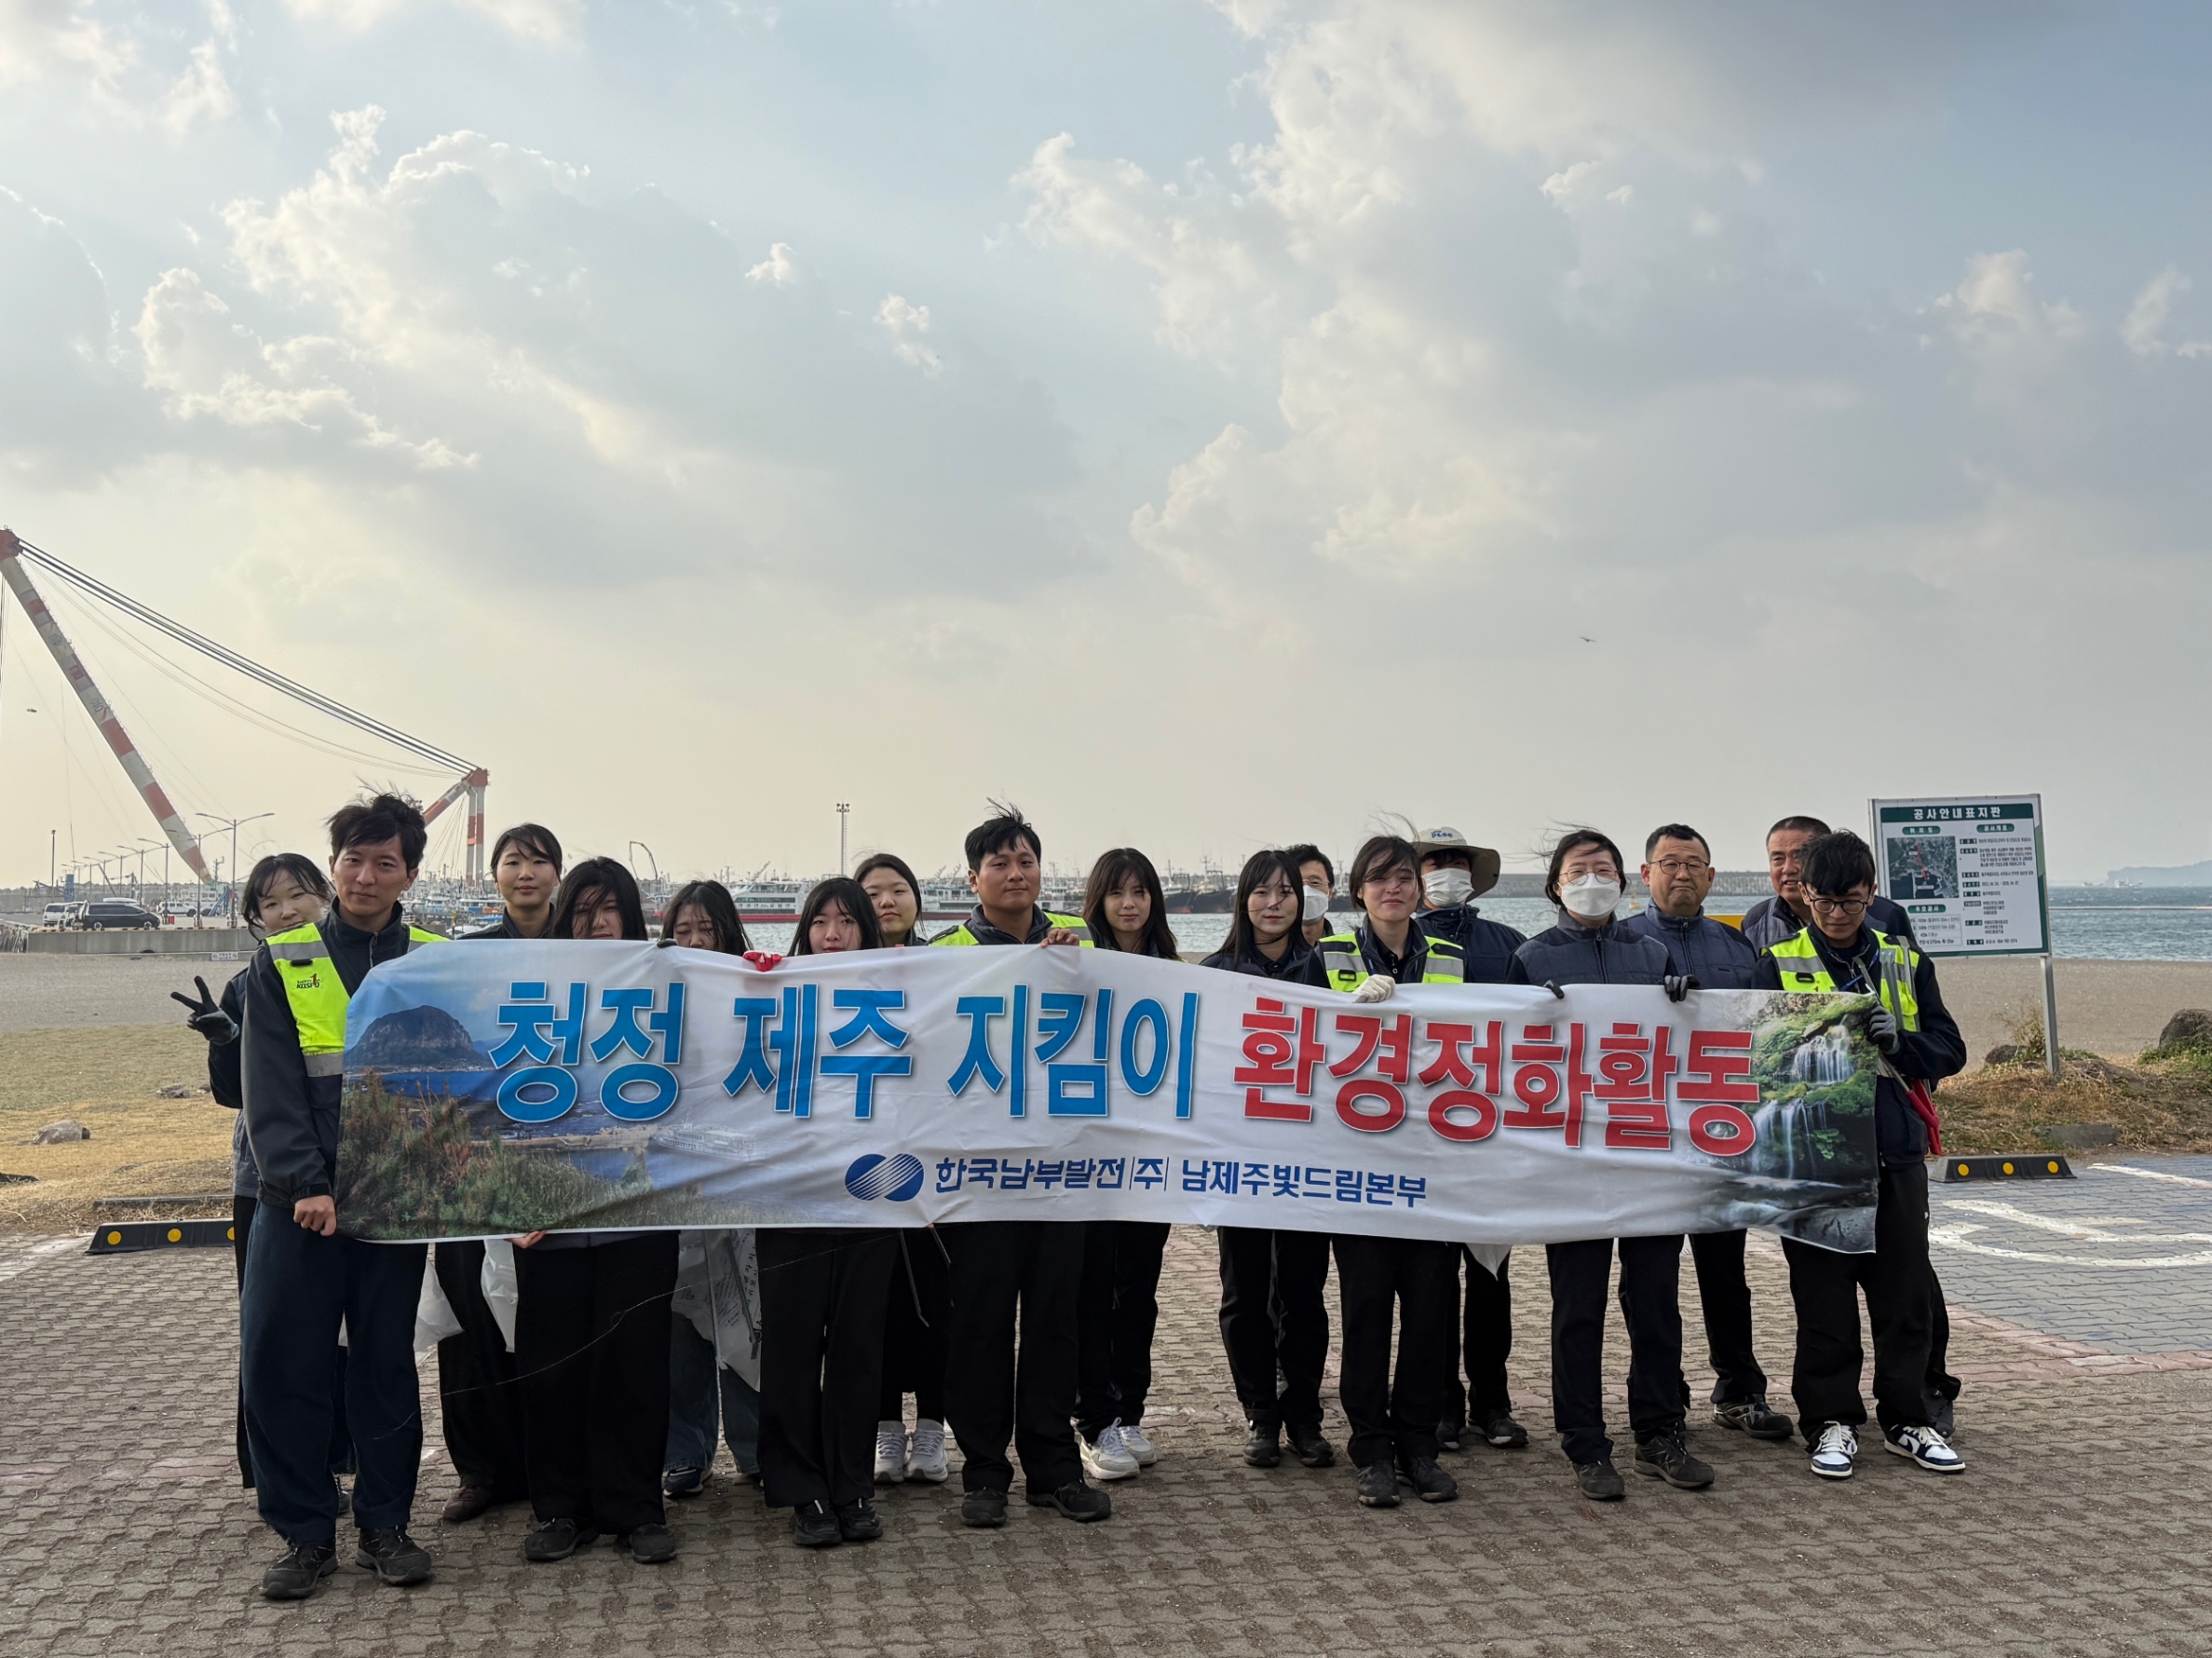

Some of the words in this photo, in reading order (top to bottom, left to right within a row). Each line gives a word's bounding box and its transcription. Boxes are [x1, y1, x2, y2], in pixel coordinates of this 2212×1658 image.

[1914, 808, 2001, 820] 공사안내표지판
[487, 981, 686, 1123] 청정
[723, 984, 913, 1120] 제주
[946, 983, 1200, 1120] 지킴이
[1233, 996, 1761, 1157] 환경정화활동
[1181, 1159, 1428, 1208] 남제주빛드림본부
